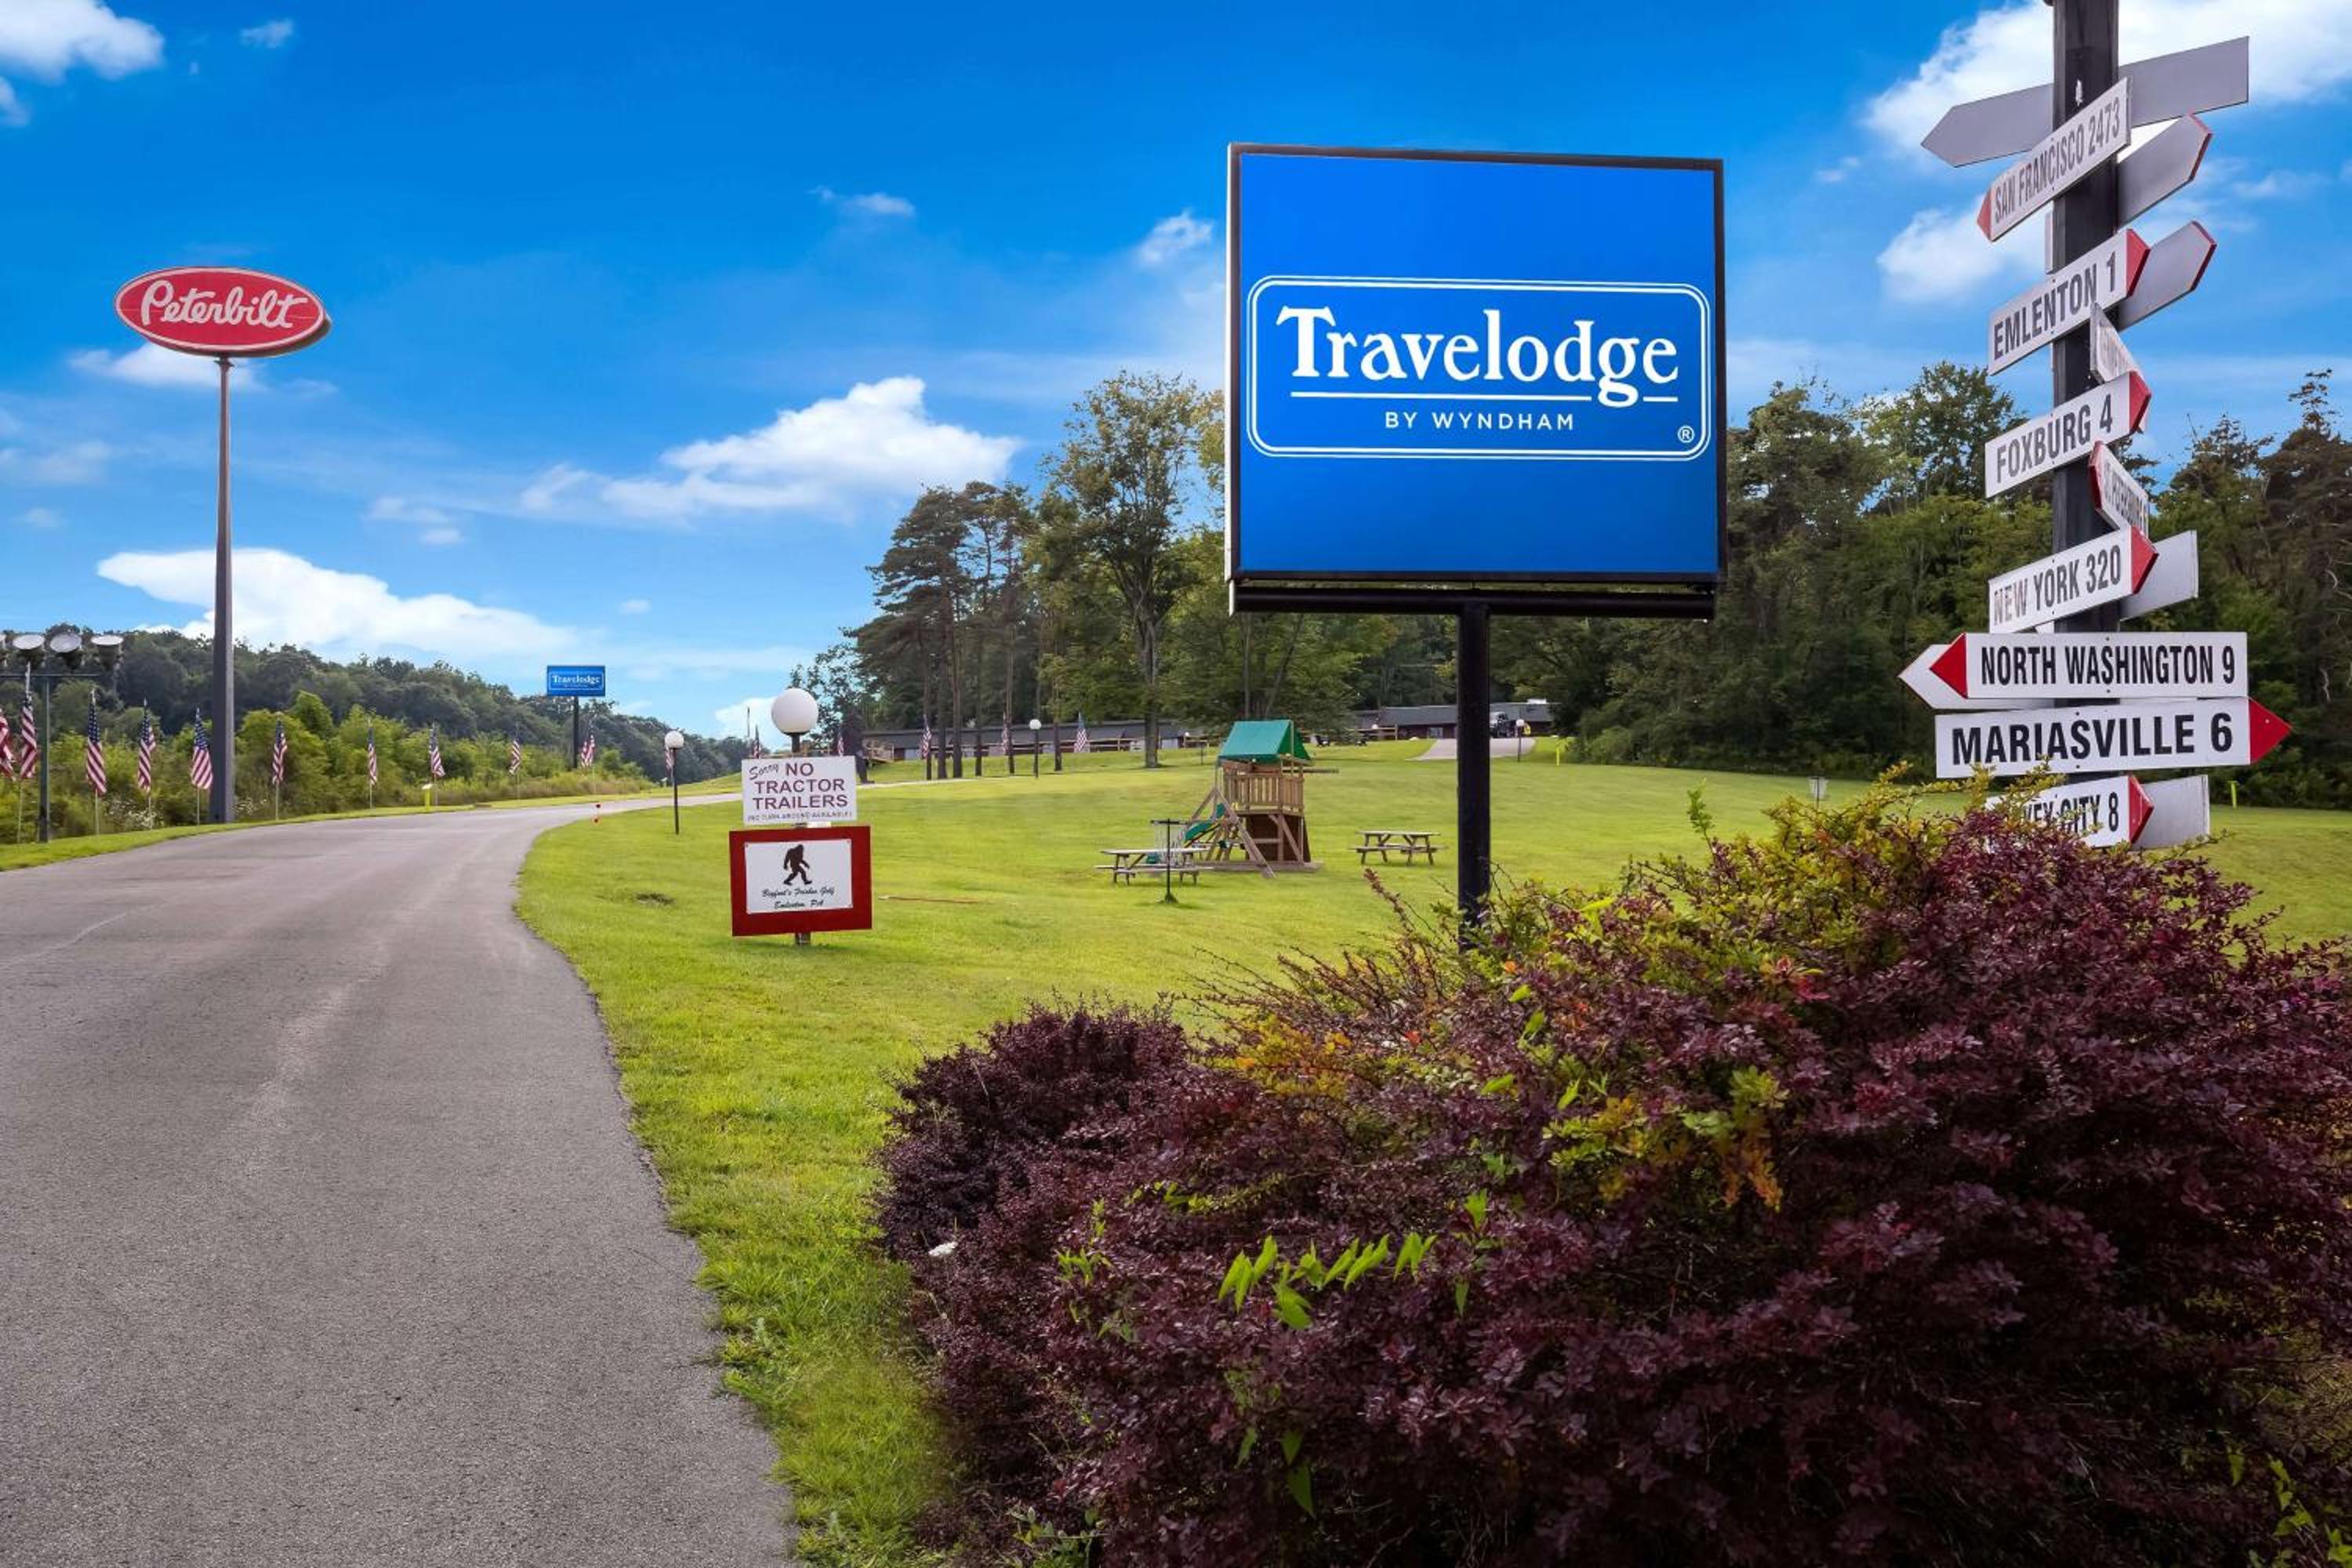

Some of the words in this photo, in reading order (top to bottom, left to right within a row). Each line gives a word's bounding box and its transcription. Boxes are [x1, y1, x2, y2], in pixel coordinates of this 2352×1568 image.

[1995, 175, 2016, 223] SAN
[2019, 123, 2084, 207] FRANCISCO
[2089, 96, 2120, 156] 2473
[140, 279, 308, 328] Peterbilt
[1994, 263, 2097, 361] EMLENTON
[2107, 251, 2116, 292] 1
[1276, 305, 1679, 408] Travelodge
[1385, 412, 1419, 430] BY
[1432, 412, 1574, 431] WYNDHAM
[1997, 404, 2091, 484] FOXBURG
[2100, 394, 2113, 433] 4
[1994, 578, 2028, 626] NEW
[2033, 559, 2080, 611] YORK
[2085, 544, 2121, 593] 320
[551, 673, 601, 684] Travelodge
[1981, 645, 2056, 685] NORTH
[2064, 645, 2214, 684] WASHINGTON
[2222, 644, 2235, 684] 9
[1952, 714, 2195, 766] MARIASVILLE
[2210, 712, 2233, 753] 6
[749, 763, 779, 780] Sorry
[786, 762, 815, 777] NO
[754, 779, 845, 794] TRACTOR
[752, 794, 848, 810] TRAILERS
[2108, 791, 2119, 833] 8
